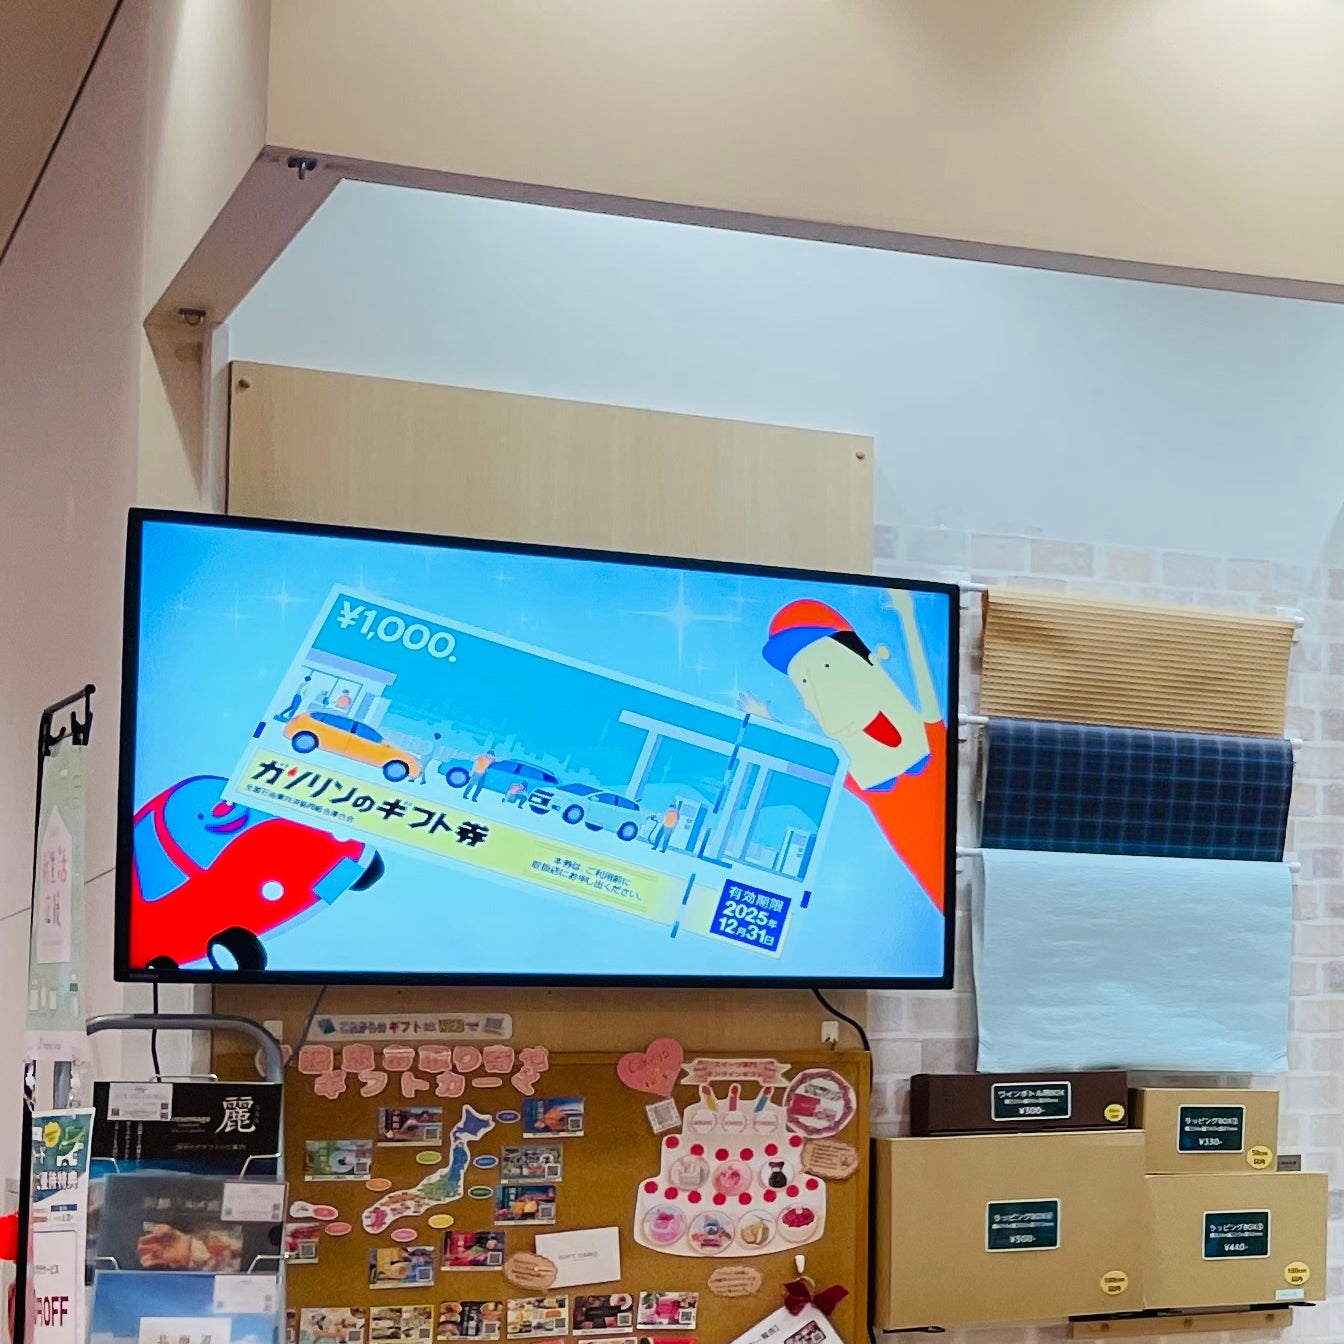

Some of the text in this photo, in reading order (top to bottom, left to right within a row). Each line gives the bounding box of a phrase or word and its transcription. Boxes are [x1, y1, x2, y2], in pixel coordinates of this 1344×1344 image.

[250, 758, 490, 848] ガソリンのギフト券
[728, 884, 785, 913] 有効期限
[723, 900, 779, 930] 2025年
[718, 917, 775, 947] 12月31日
[214, 1096, 257, 1135] 麗
